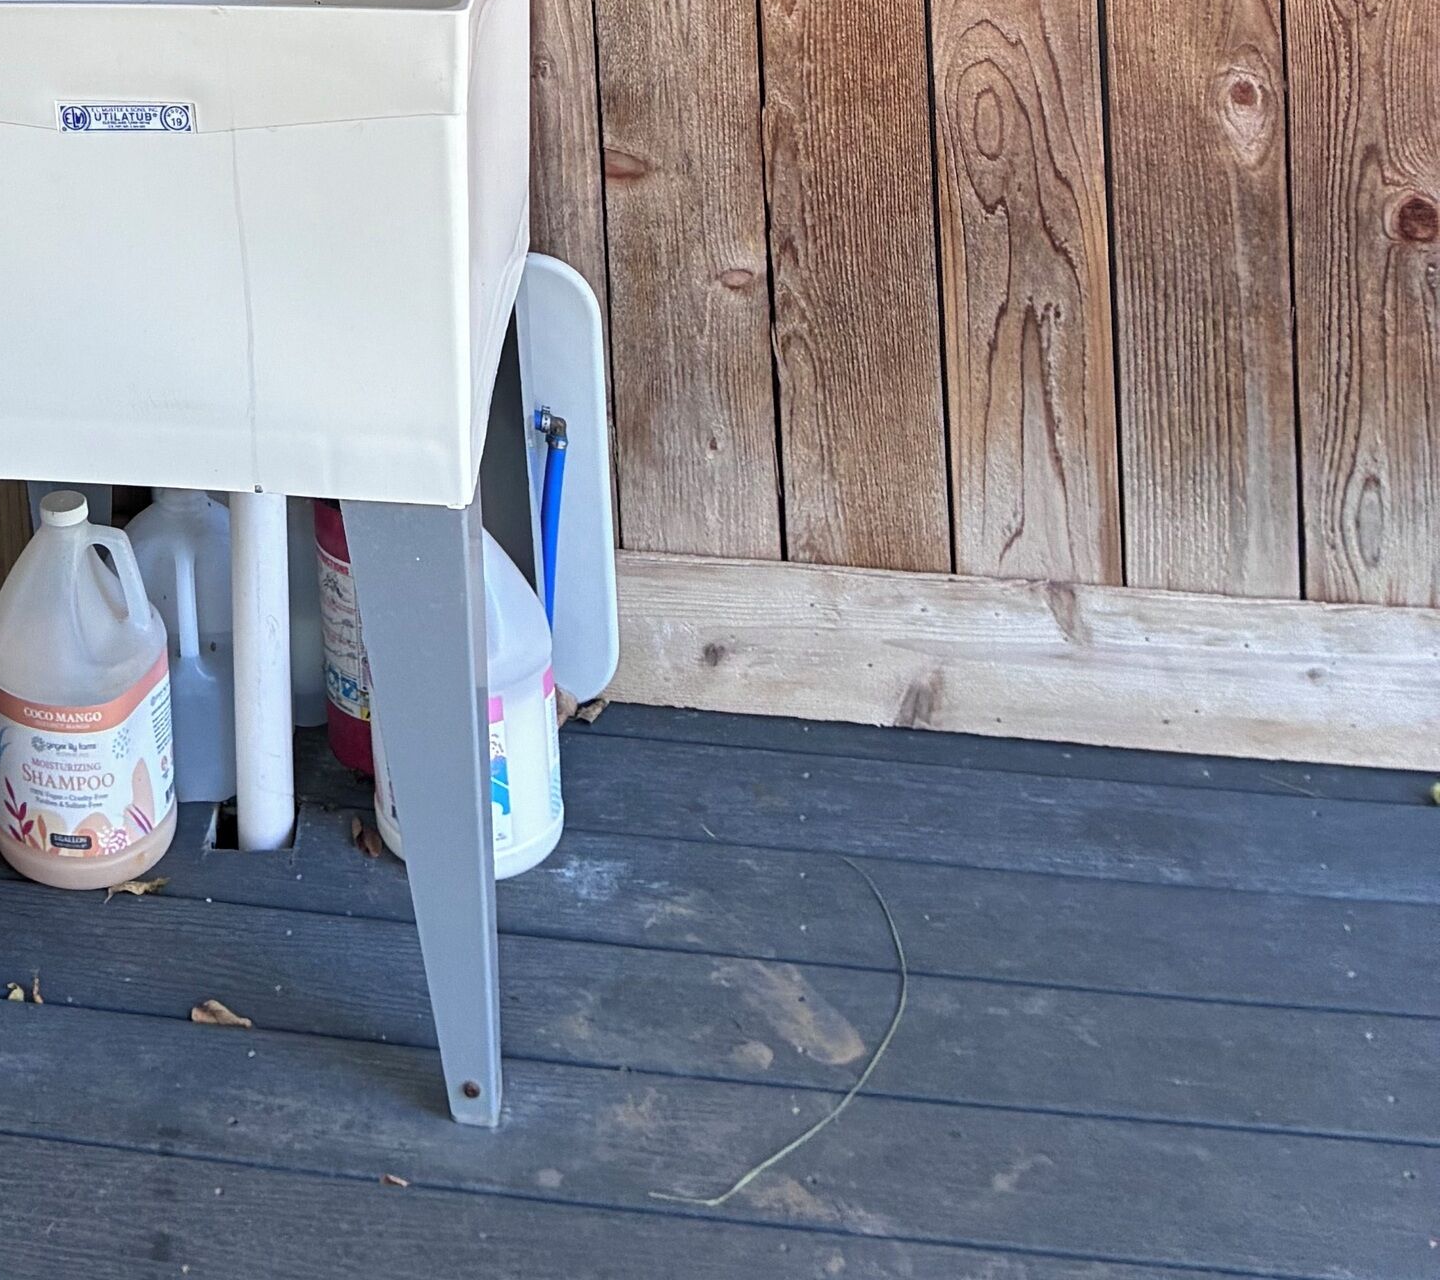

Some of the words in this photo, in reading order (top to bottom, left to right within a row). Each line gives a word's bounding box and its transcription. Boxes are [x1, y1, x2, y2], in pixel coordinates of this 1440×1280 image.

[24, 707, 53, 721] COCO
[55, 711, 102, 723] MANGO
[32, 758, 101, 772] MOISTURIZING
[22, 763, 115, 791] SHAMPOO
